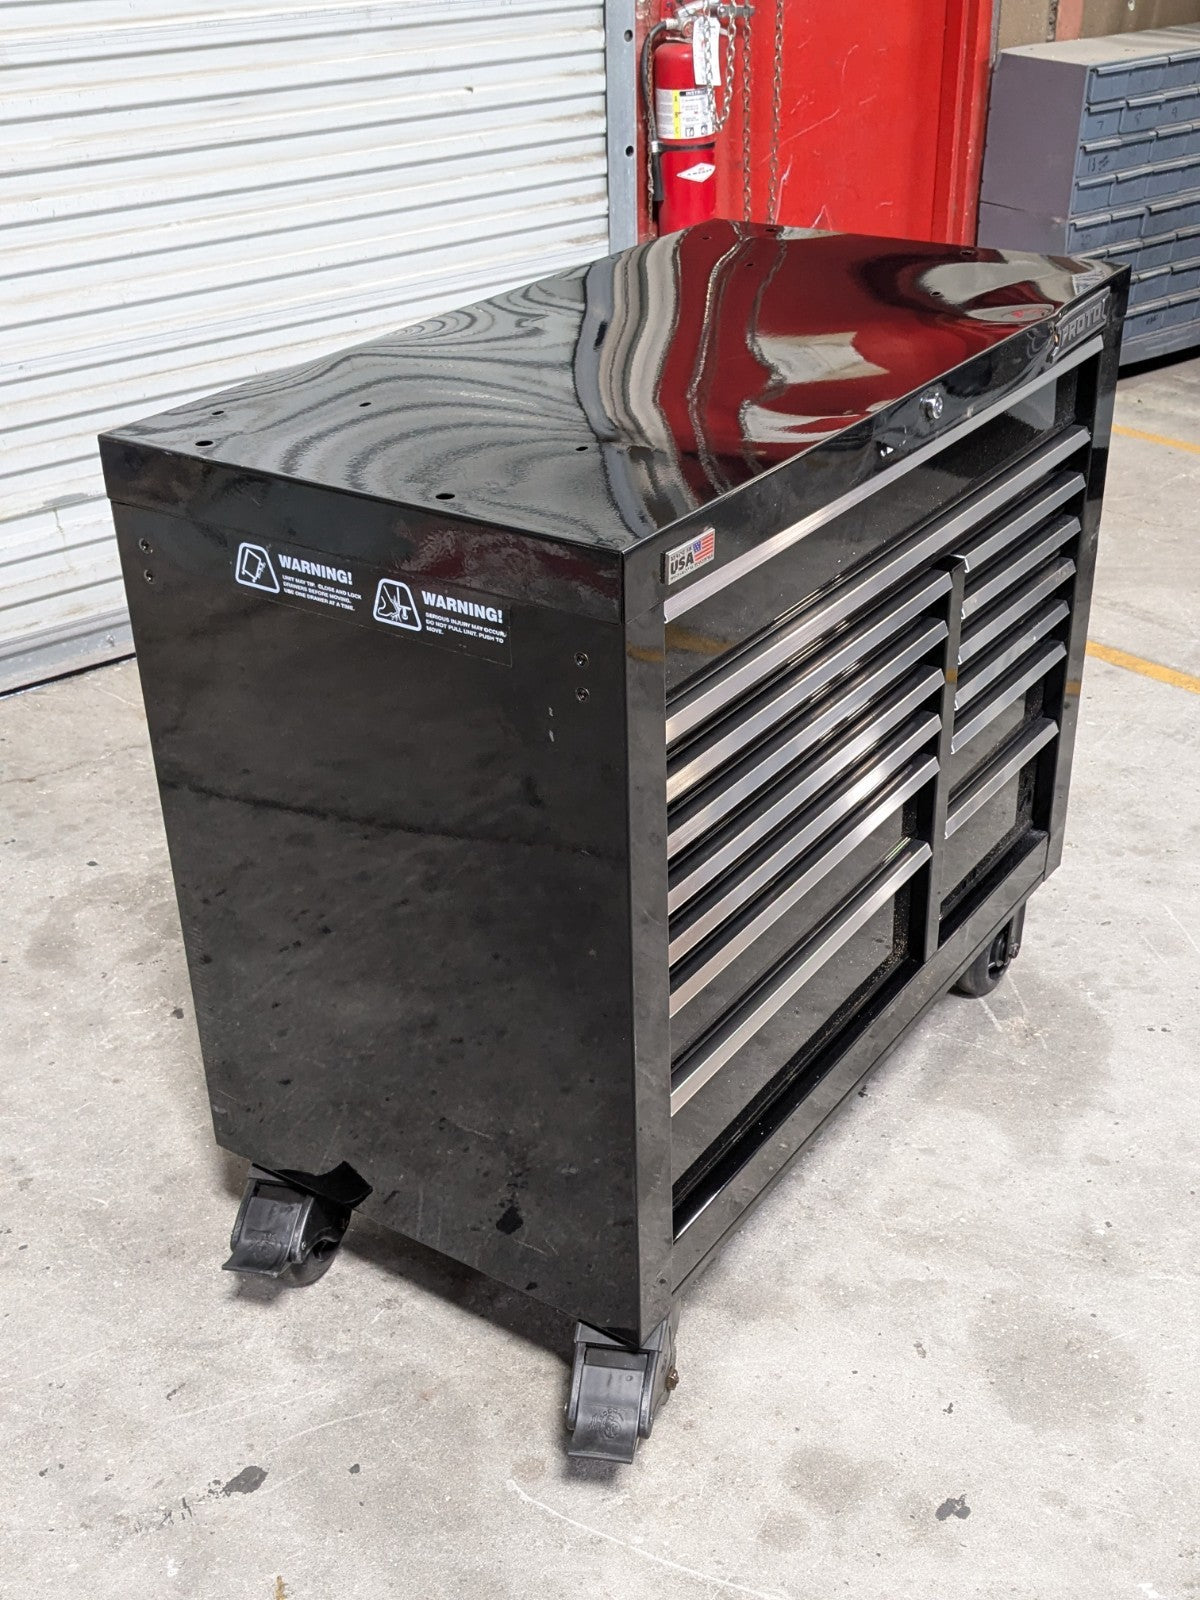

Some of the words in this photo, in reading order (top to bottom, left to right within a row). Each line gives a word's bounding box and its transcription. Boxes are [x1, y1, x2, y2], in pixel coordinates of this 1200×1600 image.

[1060, 301, 1103, 347] PROTO
[278, 553, 353, 585] WARNING!
[670, 552, 694, 575] USA
[335, 588, 347, 596] AND
[421, 589, 503, 624] WARNING!
[425, 612, 450, 623] SERIOUS
[450, 618, 471, 628] INJURY
[425, 618, 435, 626] DO
[435, 621, 447, 629] NOT
[447, 624, 463, 634] PULL
[478, 632, 495, 641] PUSH
